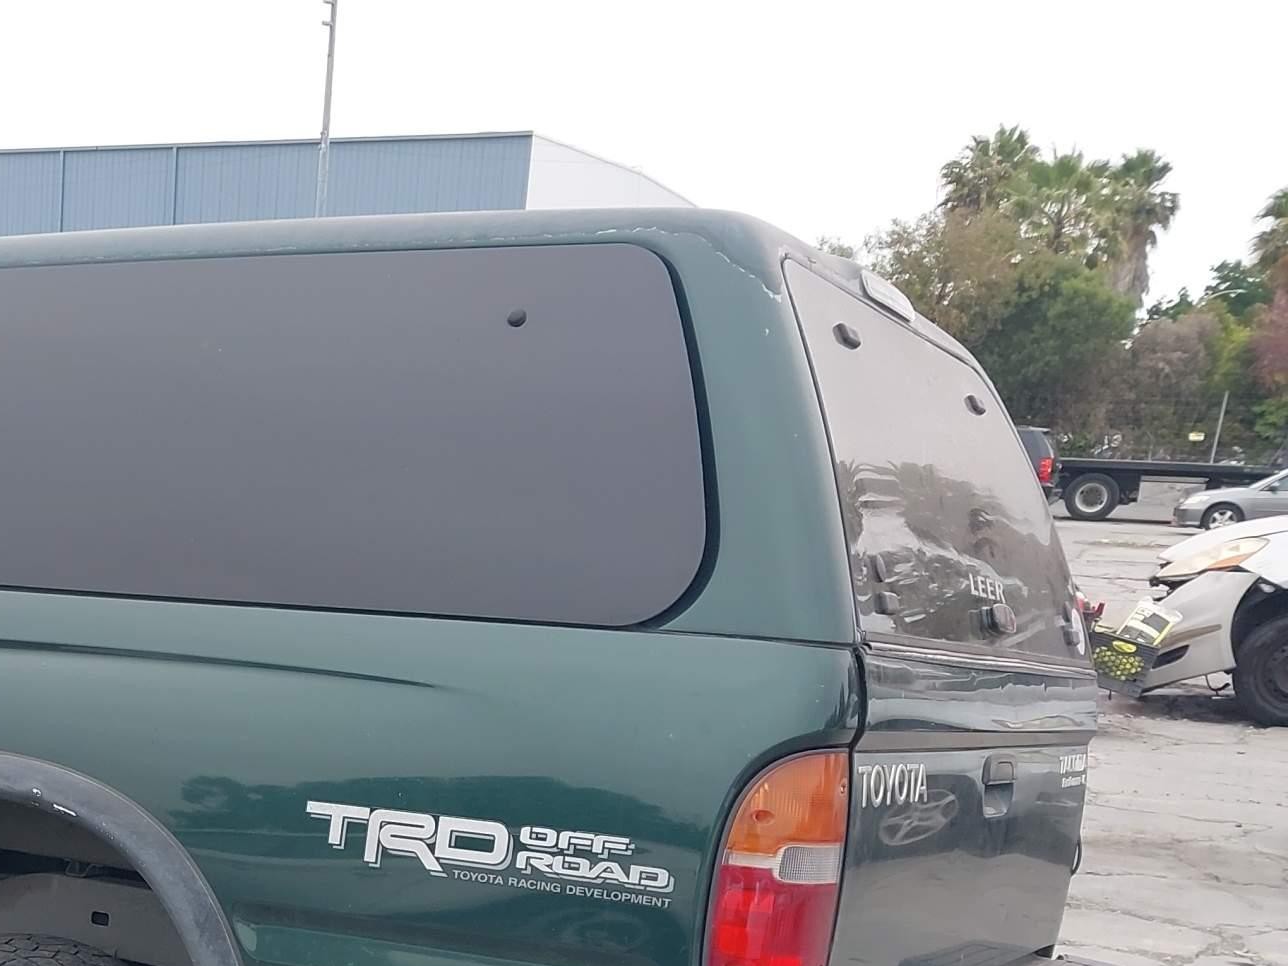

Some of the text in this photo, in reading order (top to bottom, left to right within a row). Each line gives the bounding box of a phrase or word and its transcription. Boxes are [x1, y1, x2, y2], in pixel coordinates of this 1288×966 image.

[968, 573, 1007, 604] LEER
[858, 763, 928, 809] TOYOTA
[305, 800, 514, 878] TRD
[519, 826, 635, 859] OFF
[452, 869, 672, 909] TOYOTA RACING DEVELOPMENT
[515, 850, 675, 893] ROAD
